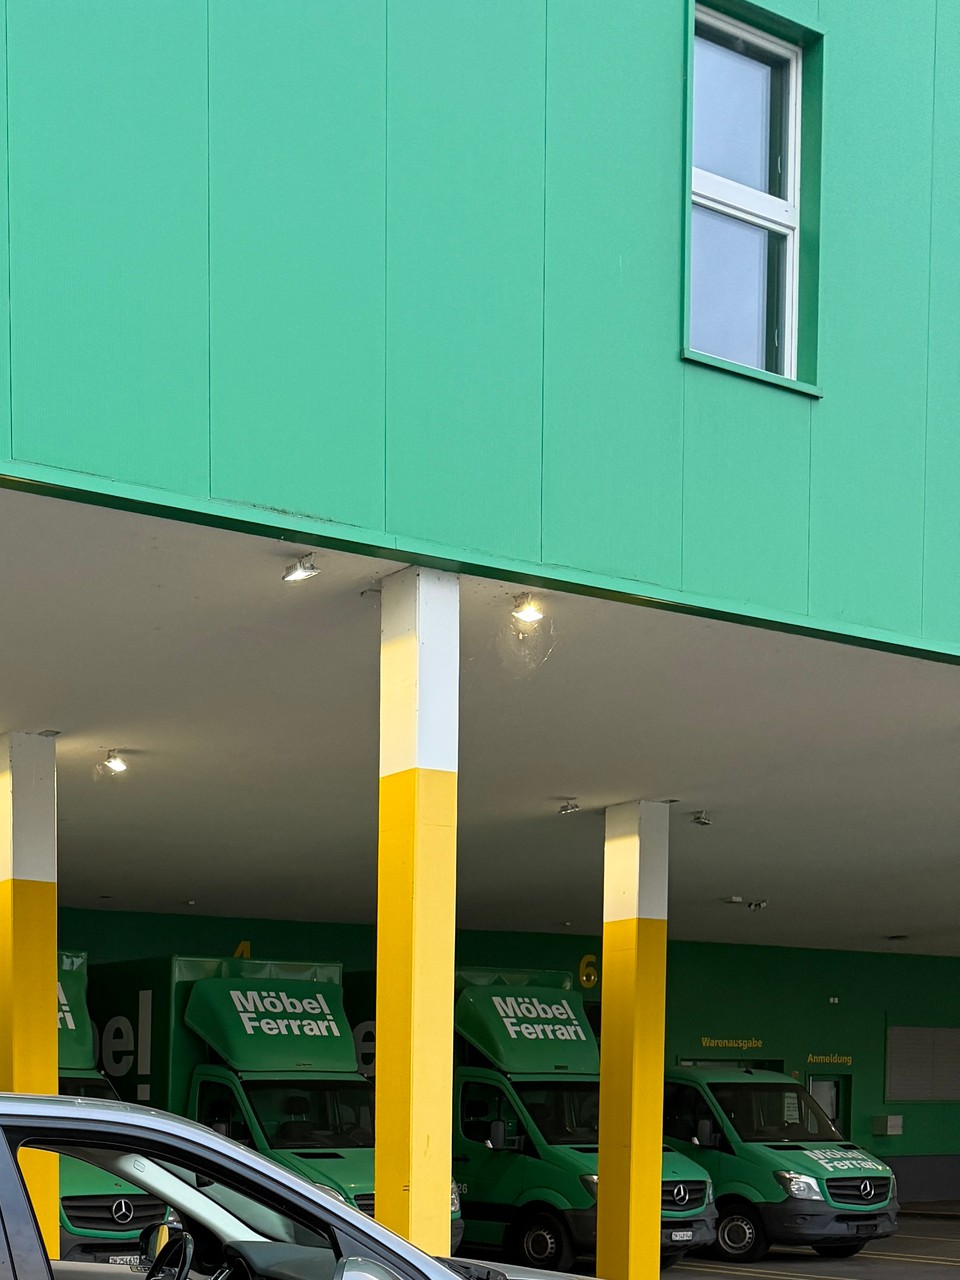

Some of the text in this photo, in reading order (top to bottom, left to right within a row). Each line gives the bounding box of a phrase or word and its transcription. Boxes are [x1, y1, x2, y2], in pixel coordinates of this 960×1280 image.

[578, 954, 598, 989] 6
[229, 990, 330, 1015] Möbel
[491, 996, 576, 1019] Möbel
[240, 1013, 341, 1037] Ferrari
[502, 1018, 587, 1041] Ferrari
[701, 1037, 763, 1050] Warenausgabe
[807, 1053, 852, 1066] Anmeldung
[802, 1149, 871, 1162] Möbel
[818, 1159, 882, 1172] Ferrari
